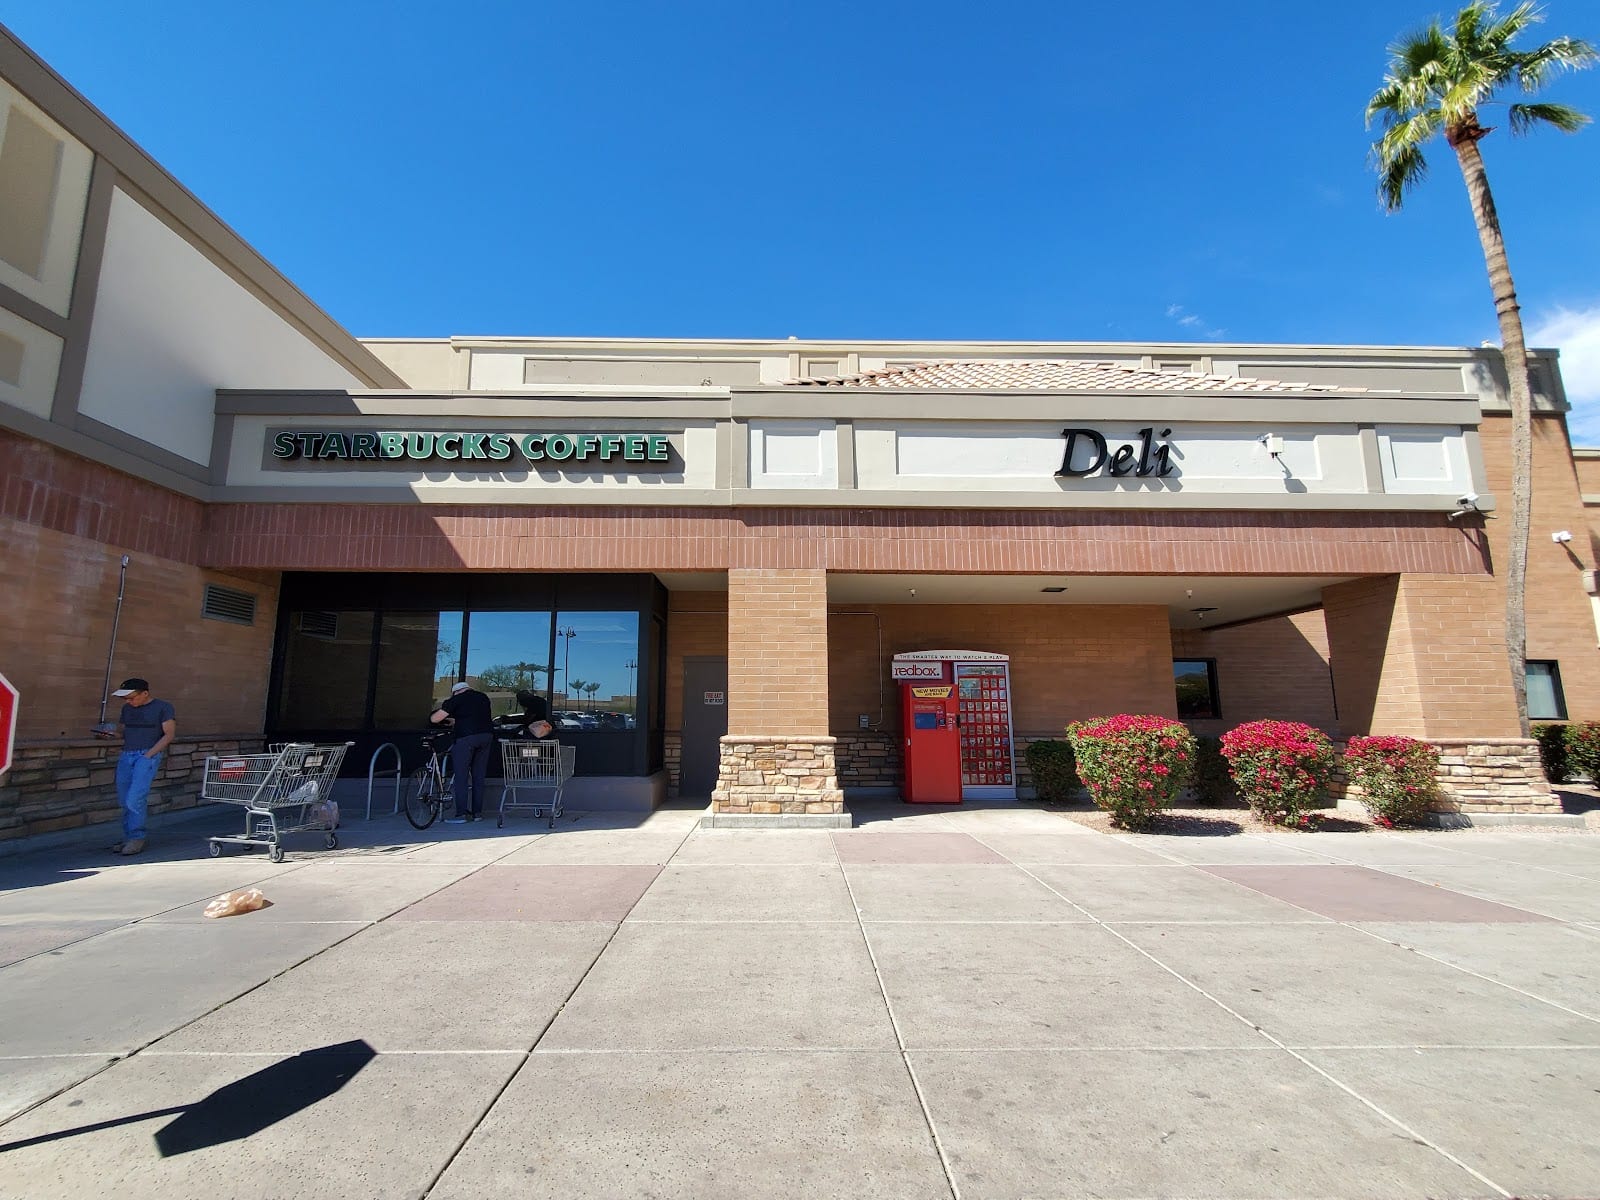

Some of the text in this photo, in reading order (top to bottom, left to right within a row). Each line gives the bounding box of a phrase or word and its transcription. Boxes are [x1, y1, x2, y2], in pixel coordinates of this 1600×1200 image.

[272, 431, 669, 461] STARBUCKS COFFEE
[1054, 427, 1174, 477] Deli
